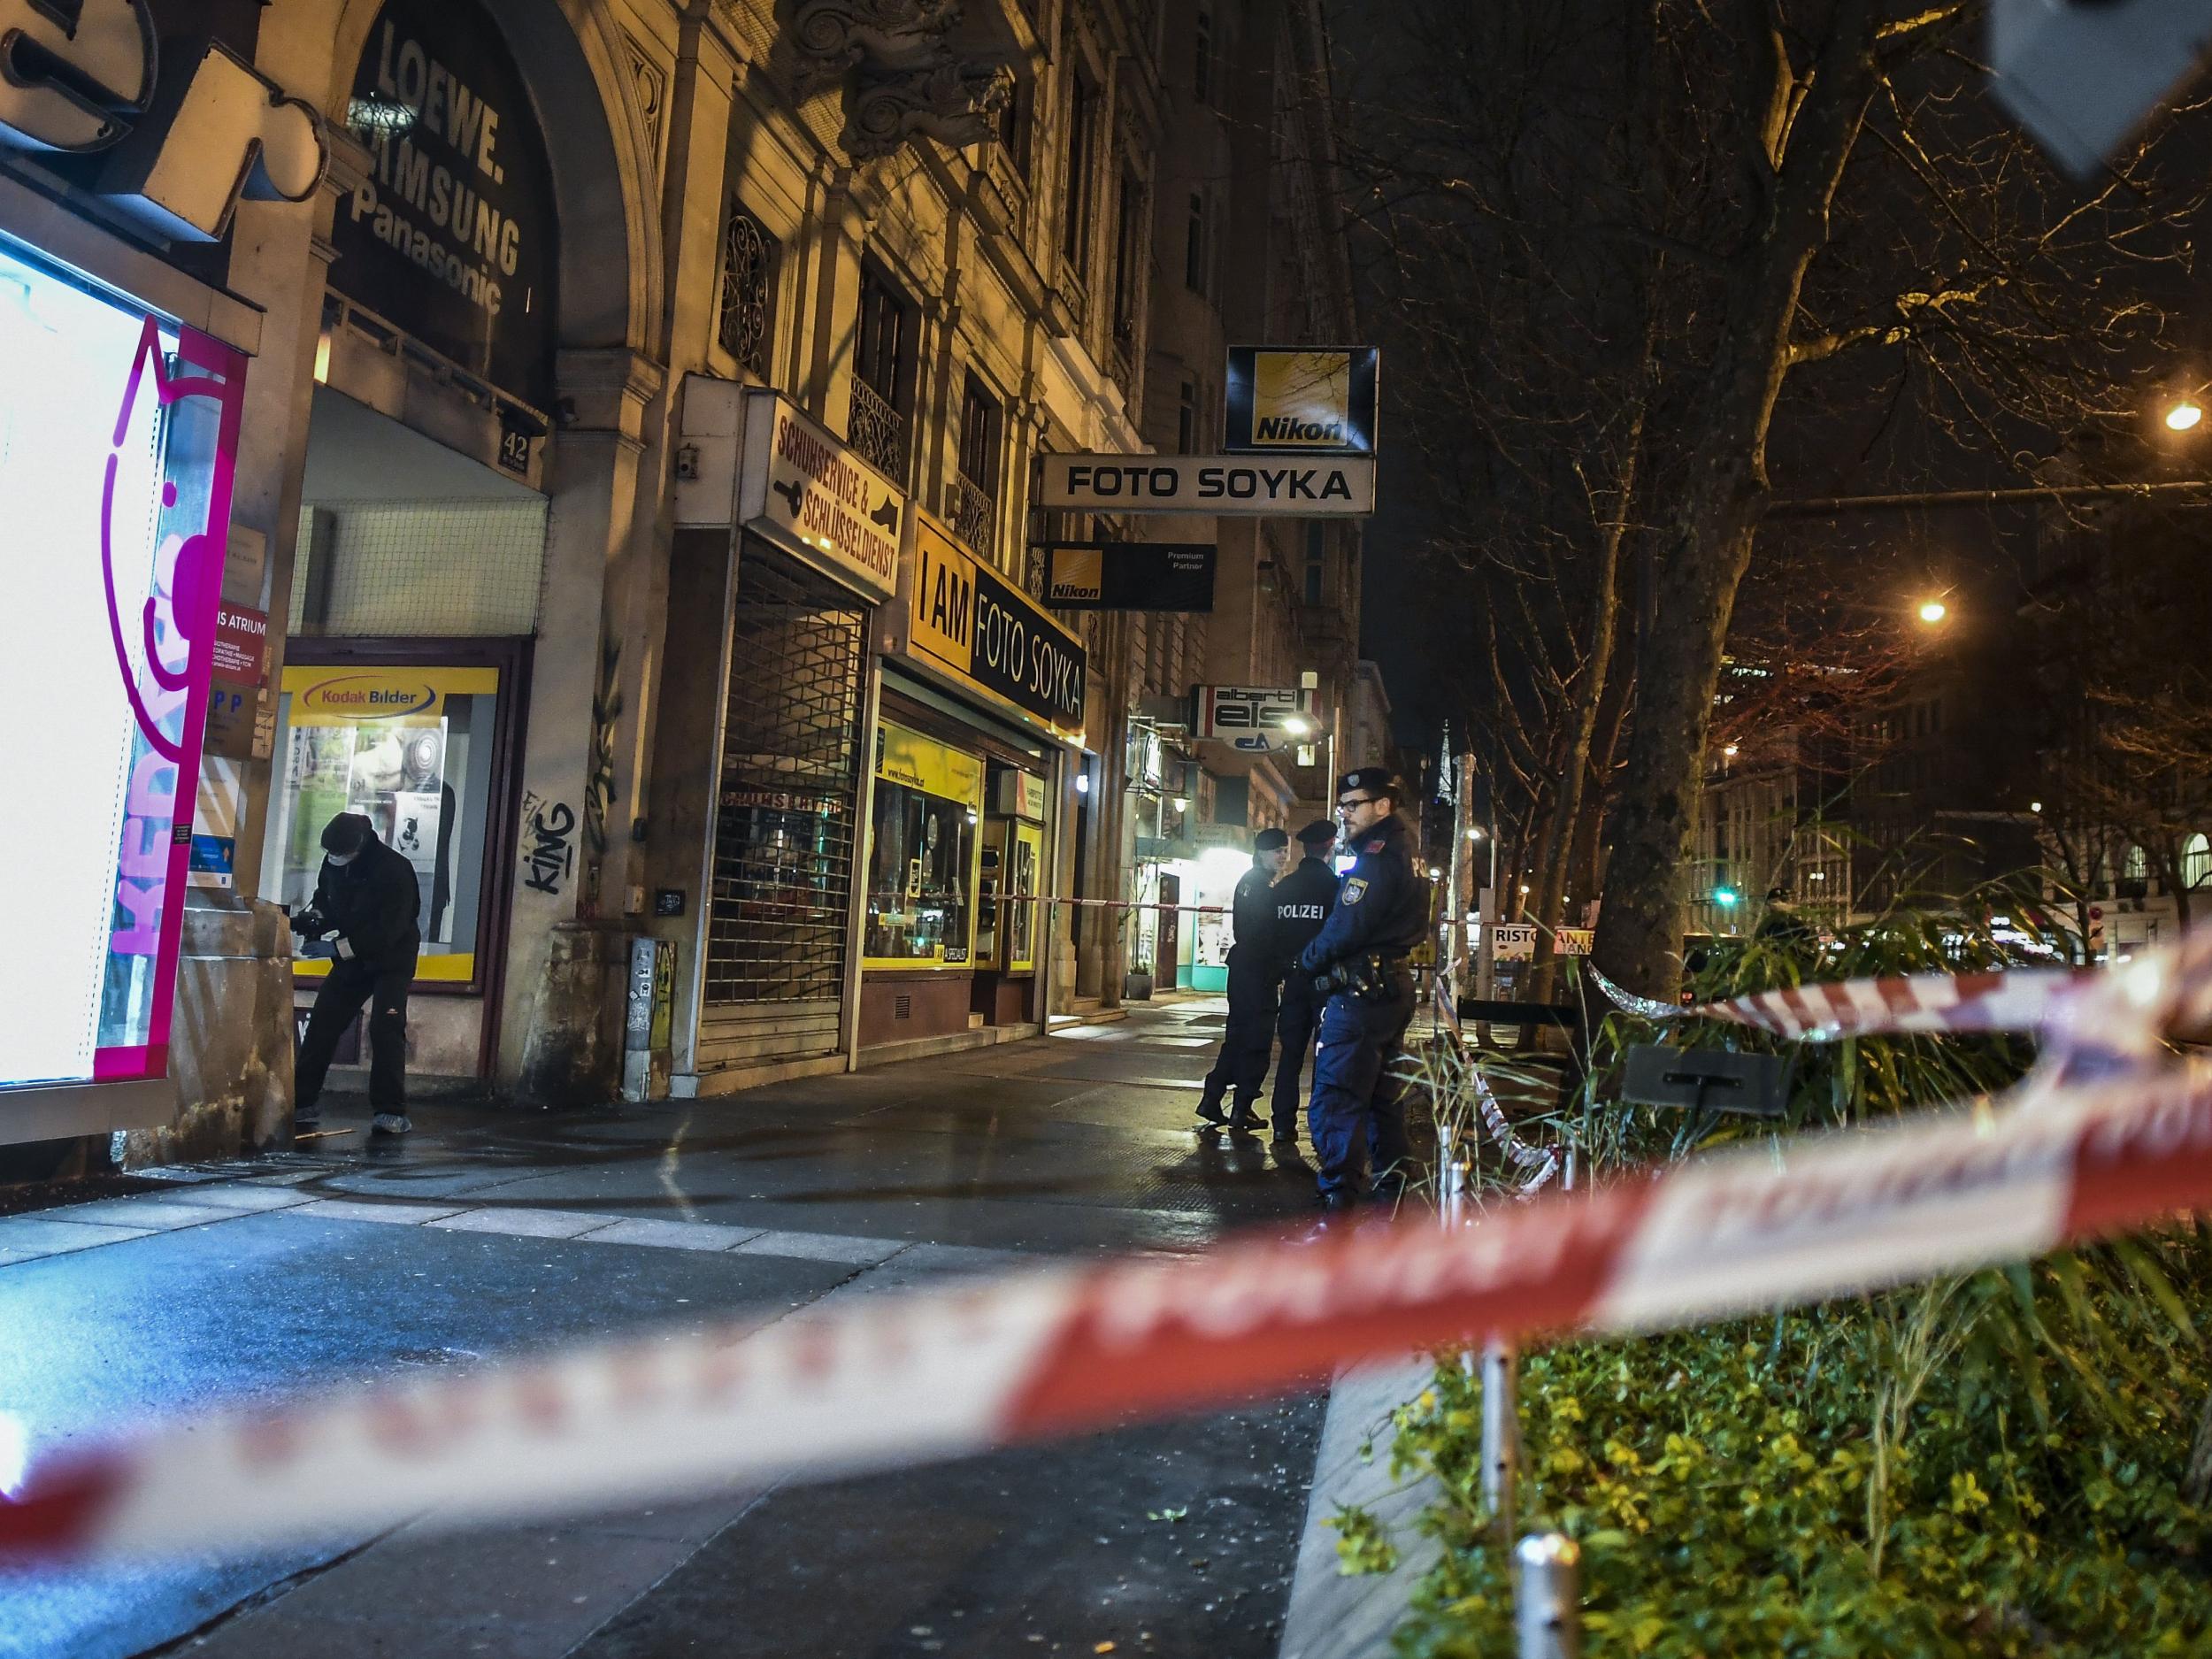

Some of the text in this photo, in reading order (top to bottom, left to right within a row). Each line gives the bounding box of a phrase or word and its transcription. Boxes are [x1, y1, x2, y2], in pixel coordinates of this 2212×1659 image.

[351, 177, 502, 316] Panasonic
[1256, 417, 1342, 441] Nikon
[504, 432, 527, 461] 42
[778, 415, 869, 516] SCHUHSERVICE &
[1067, 466, 1353, 500] FOTO SOYKA
[803, 488, 895, 580] SCHLÜSSELDIENST
[1167, 551, 1204, 560] Premium
[1052, 584, 1099, 598] Nikon
[228, 615, 267, 636] ATRIUM
[919, 550, 1081, 719] I AM FOTO SOYKA
[322, 690, 417, 703] Kodak Bilder
[1217, 688, 1295, 703] alberti
[1215, 702, 1295, 728] eis
[1278, 904, 1324, 920] POLIZEI
